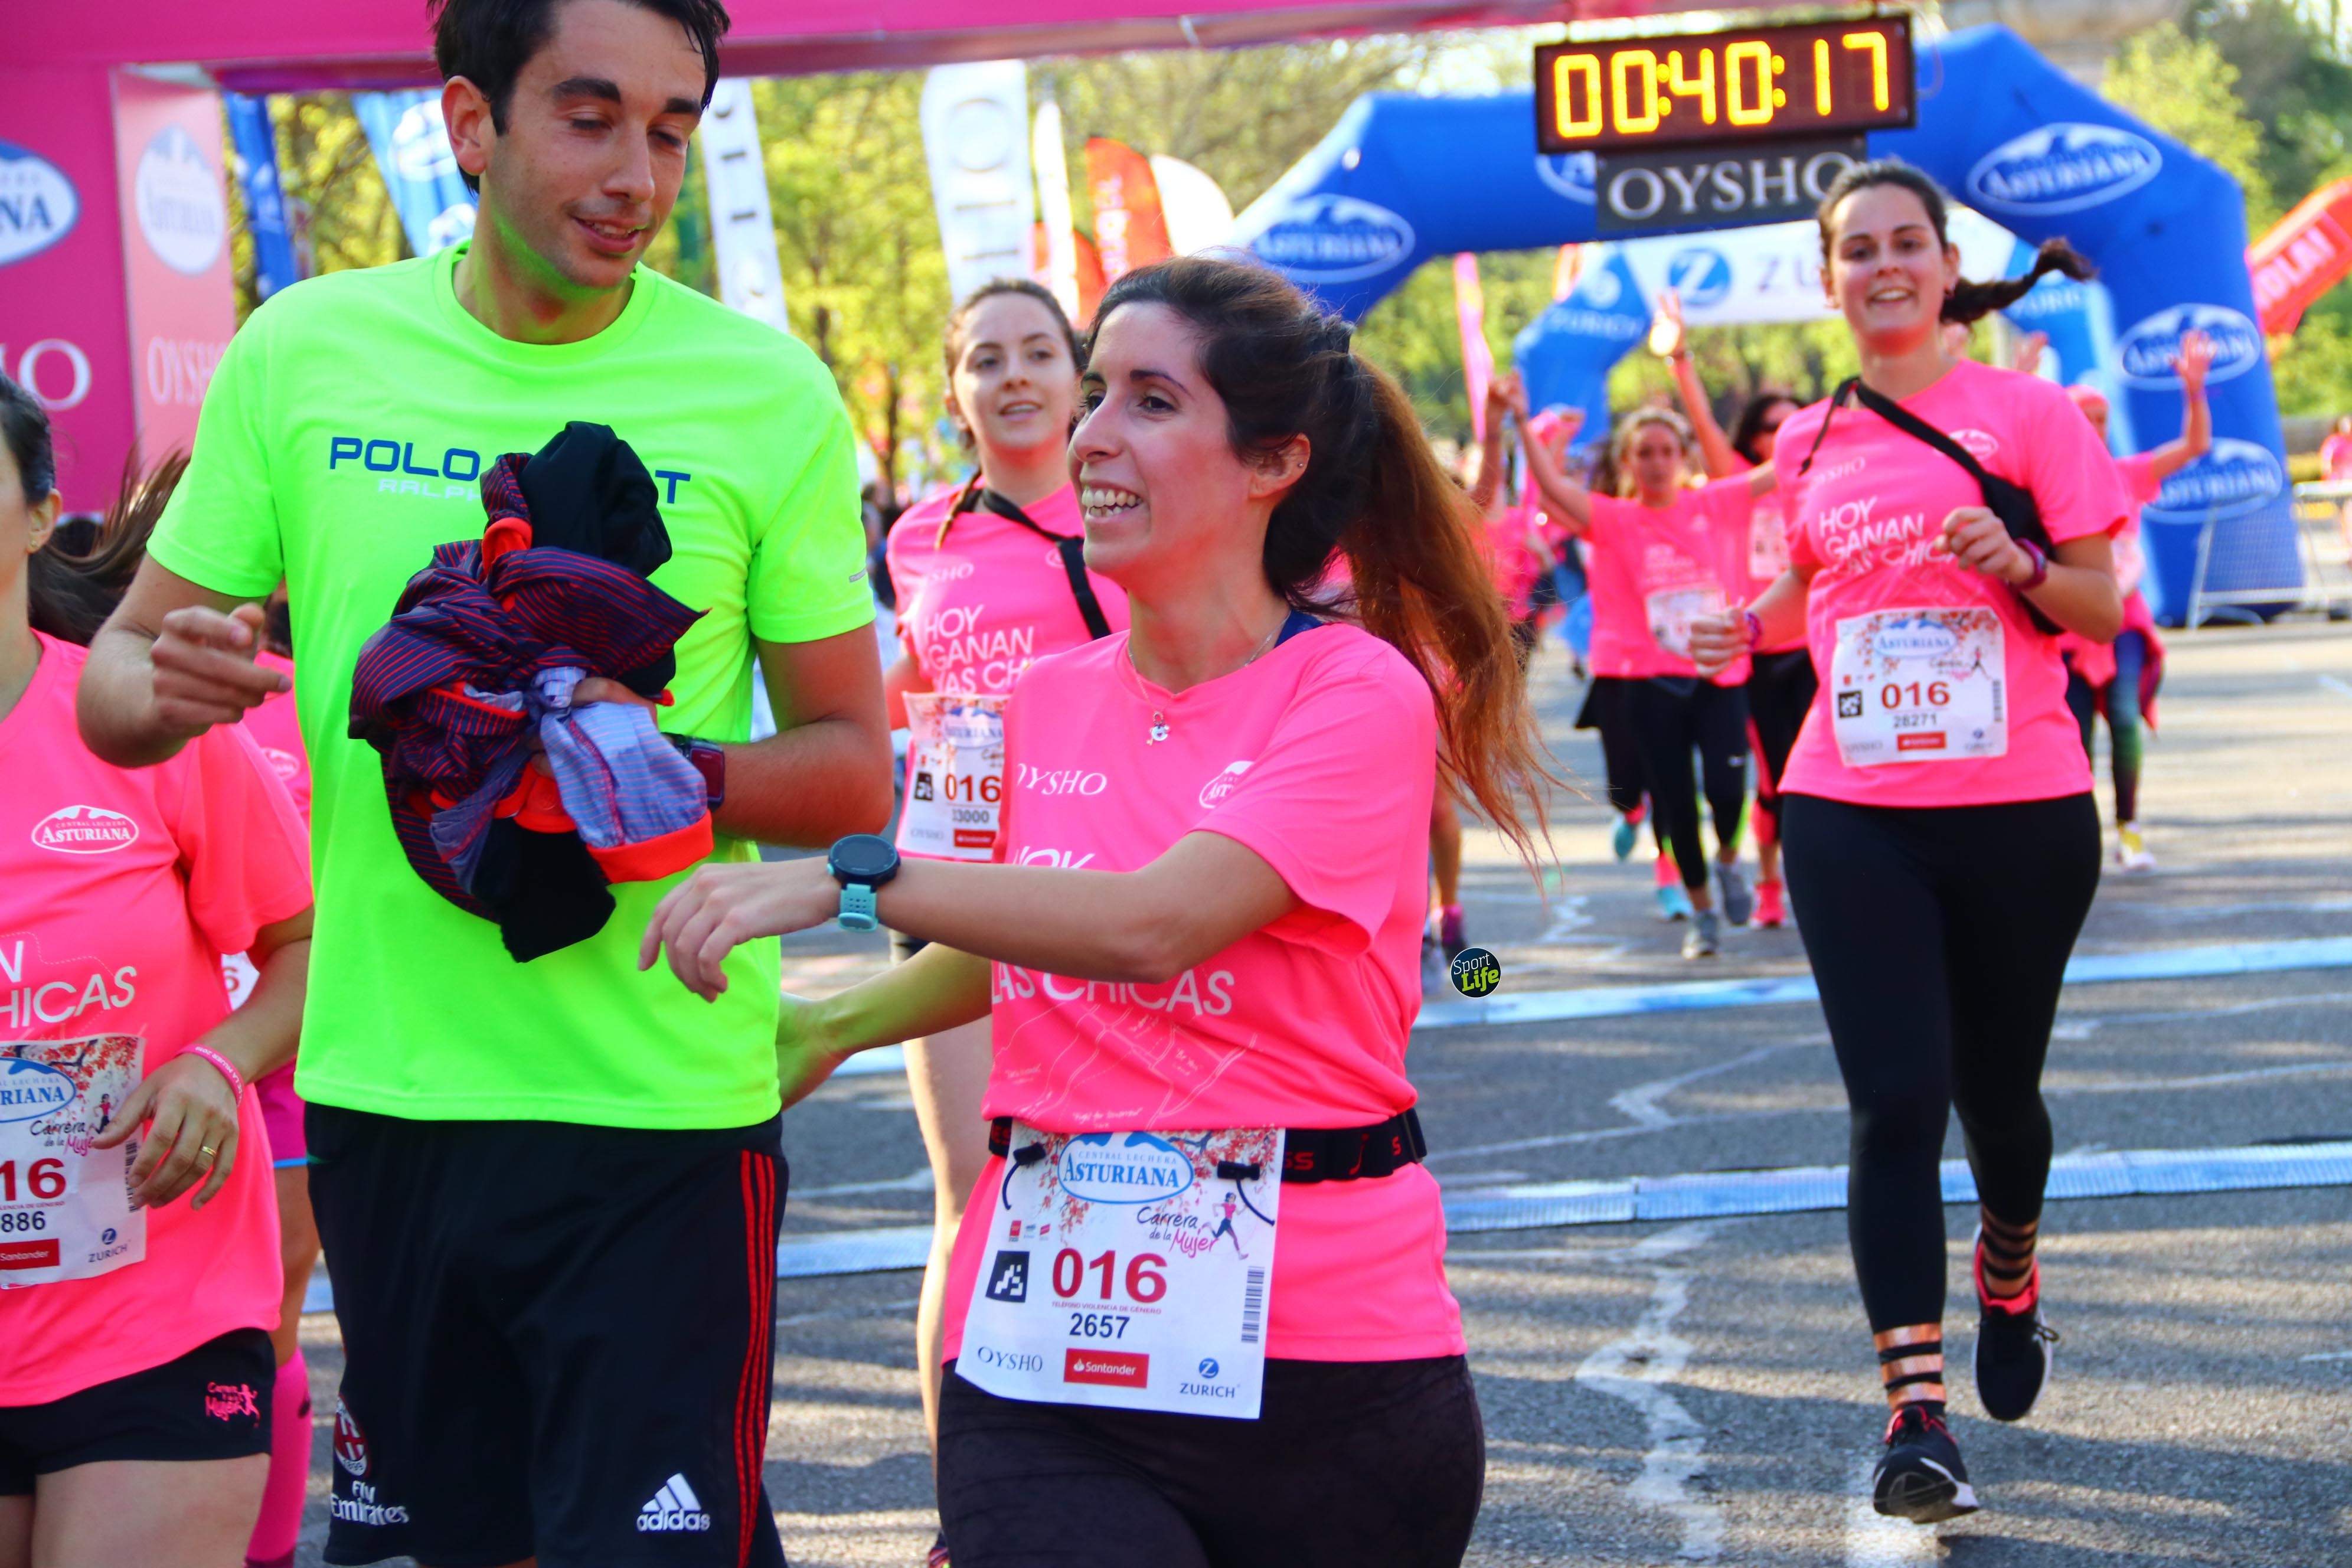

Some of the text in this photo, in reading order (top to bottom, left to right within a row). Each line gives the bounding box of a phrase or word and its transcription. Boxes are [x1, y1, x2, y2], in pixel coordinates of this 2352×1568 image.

[1554, 31, 1889, 138] 00:40:17
[1608, 151, 1856, 220] OYSHO
[329, 437, 481, 481] POLO
[1819, 496, 1878, 538] HOY
[1824, 512, 1925, 562] GANAN
[925, 604, 984, 641] HOY
[927, 626, 1034, 671] GANAN
[1881, 681, 1951, 709] 016
[945, 772, 1002, 803] 016
[41, 826, 132, 844] ASTURIANA
[30, 1120, 86, 1136] Carrera
[1063, 1153, 1180, 1188] ASTURIANA
[1078, 1151, 1177, 1165] CENTRAL LECHERA
[1, 1211, 46, 1233] 886
[1137, 1206, 1199, 1229] Carrera
[88, 1243, 128, 1263] ZURICH
[1149, 1227, 1220, 1259] de la Mujer
[1052, 1247, 1168, 1304] 016
[1082, 1302, 1118, 1311] VIOLENCIA
[1069, 1312, 1131, 1340] 2657
[978, 1346, 1043, 1372] OYSHO
[1085, 1361, 1137, 1376] Santander
[1180, 1383, 1235, 1398] ZURICH
[352, 1480, 376, 1504] Fly
[331, 1492, 410, 1525] Emirates
[636, 1508, 711, 1532] adidas
